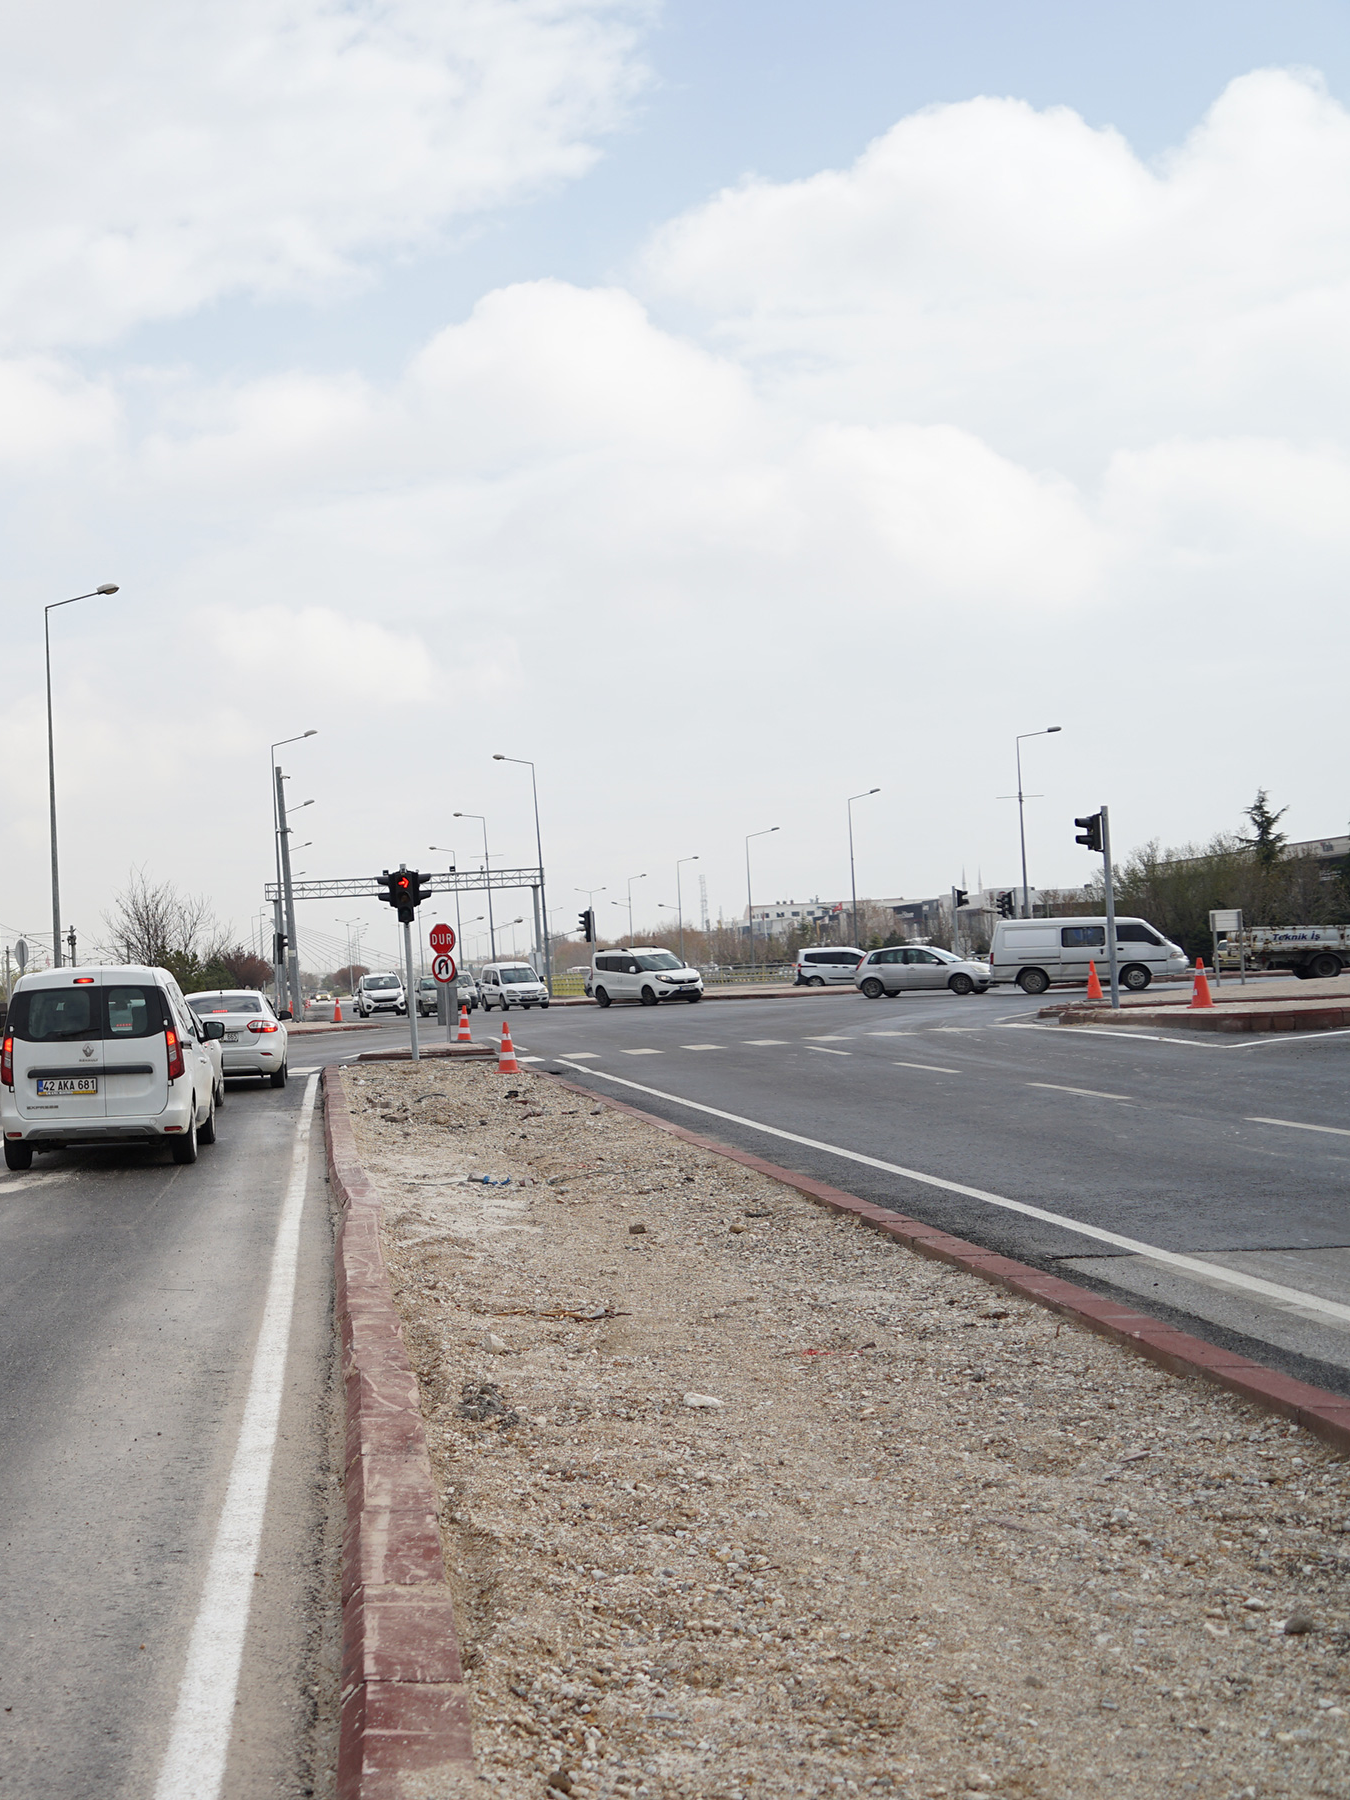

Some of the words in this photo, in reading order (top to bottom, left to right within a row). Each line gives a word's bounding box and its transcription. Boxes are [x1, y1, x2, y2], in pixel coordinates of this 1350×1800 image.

[432, 933, 452, 945] DUR
[1272, 933, 1308, 941] Teknik
[43, 1081, 55, 1091] 42
[58, 1080, 75, 1091] AKA
[78, 1079, 95, 1090] 681
